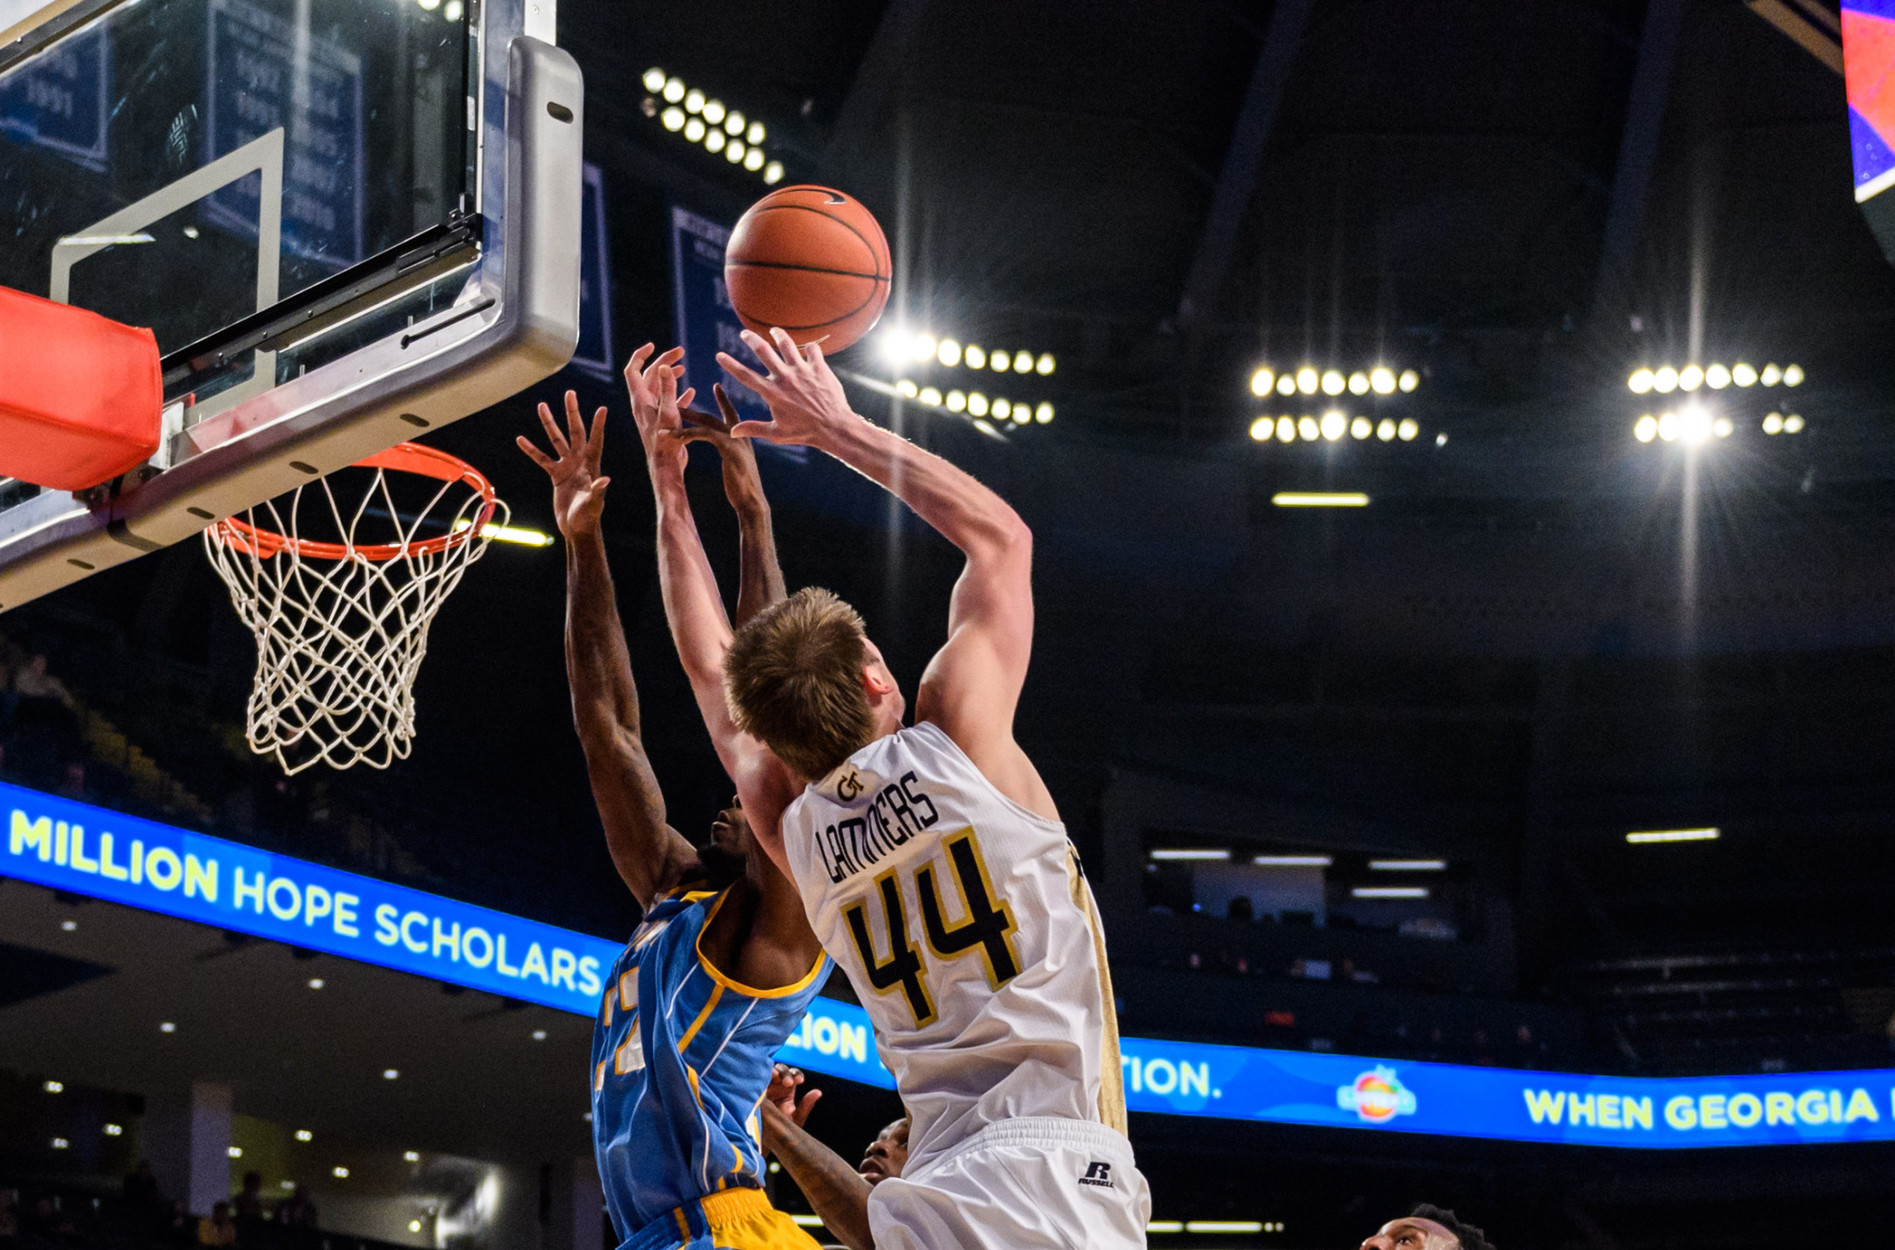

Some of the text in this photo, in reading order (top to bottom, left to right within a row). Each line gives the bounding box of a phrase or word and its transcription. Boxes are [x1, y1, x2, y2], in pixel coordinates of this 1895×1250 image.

[814, 770, 939, 884] LAMMERS
[10, 809, 218, 902] MILLION
[233, 866, 361, 937] HOPE
[374, 904, 601, 996] SCHOLARS
[840, 827, 1024, 1030] 44
[1524, 1089, 1653, 1129] WHEN
[1664, 1088, 1879, 1130] GEORGIA
[1078, 1178, 1114, 1188] RUSSELL
